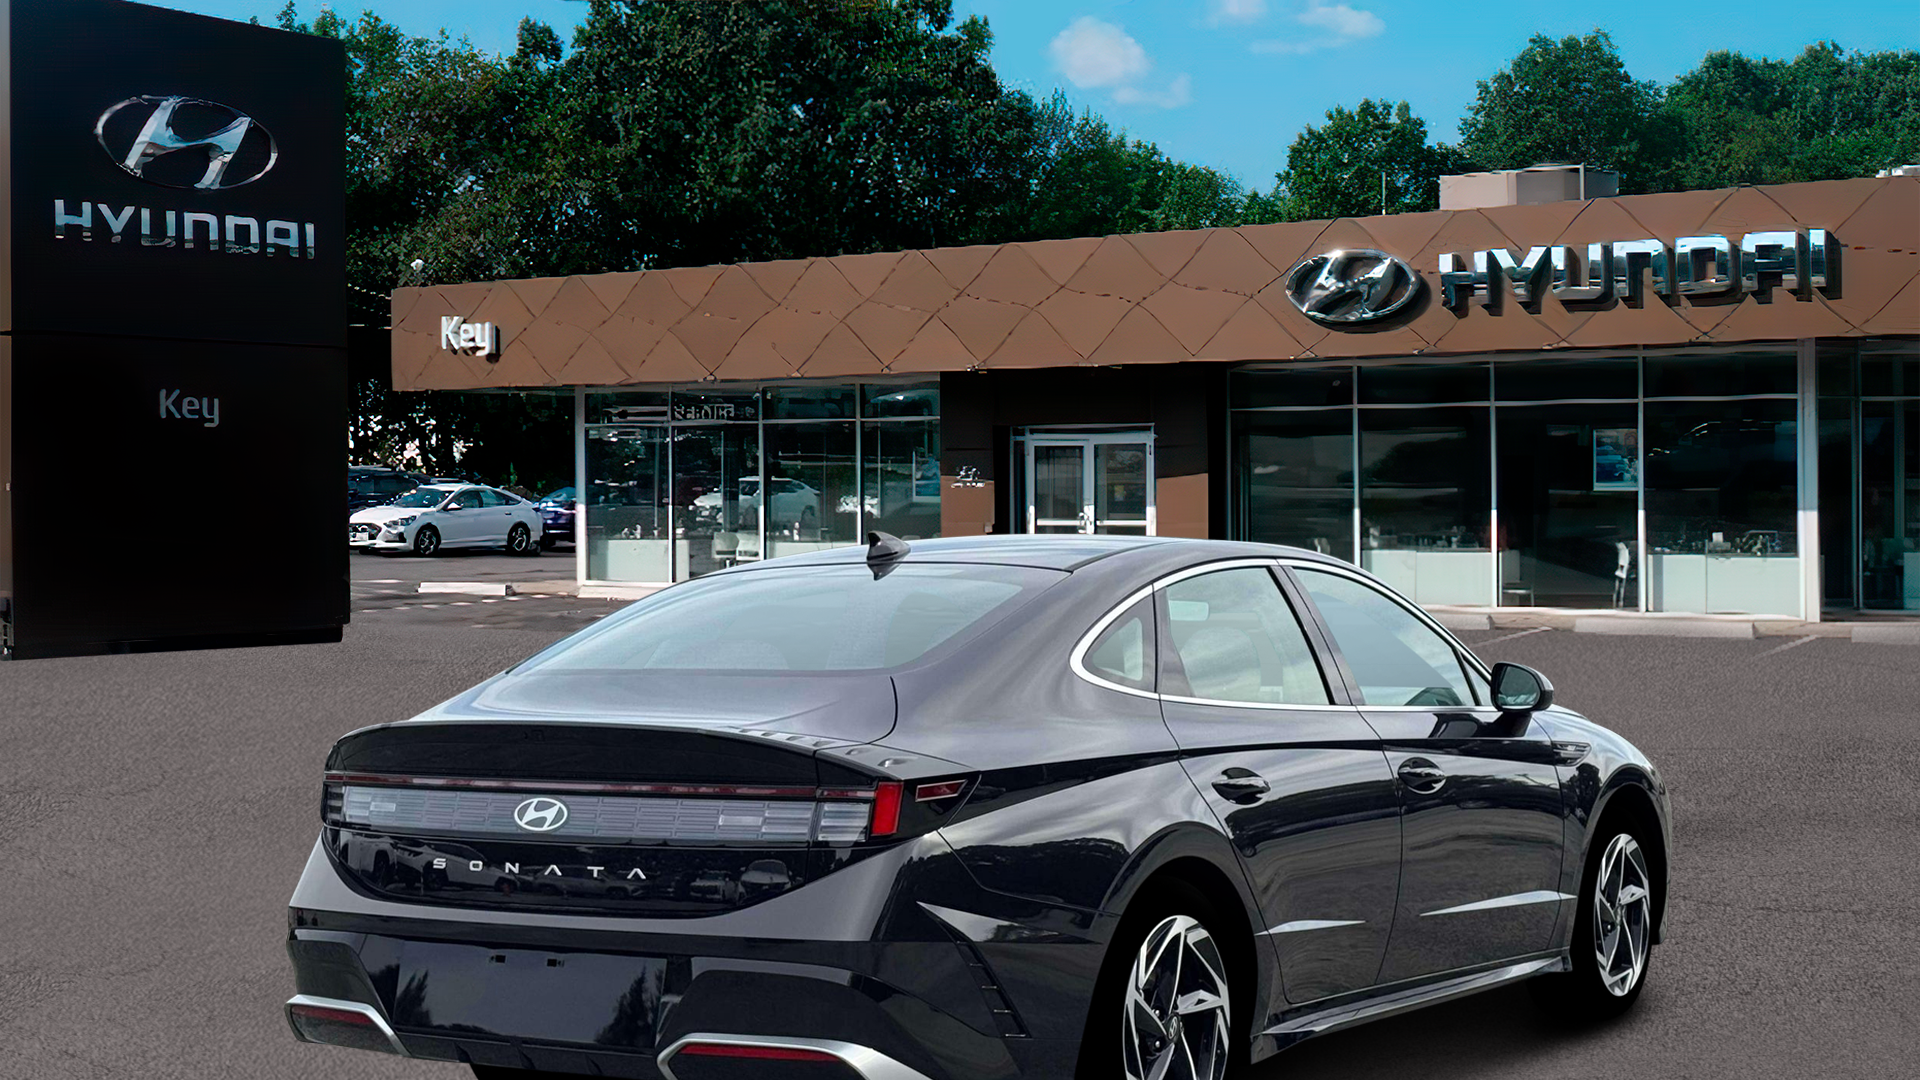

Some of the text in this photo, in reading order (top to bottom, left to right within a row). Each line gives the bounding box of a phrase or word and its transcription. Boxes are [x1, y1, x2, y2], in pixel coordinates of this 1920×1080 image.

[54, 199, 315, 259] HYUNDAI
[1438, 228, 1841, 318] HYUNDAI
[441, 316, 493, 357] Key
[159, 389, 220, 427] Key
[432, 857, 646, 880] SONATA
